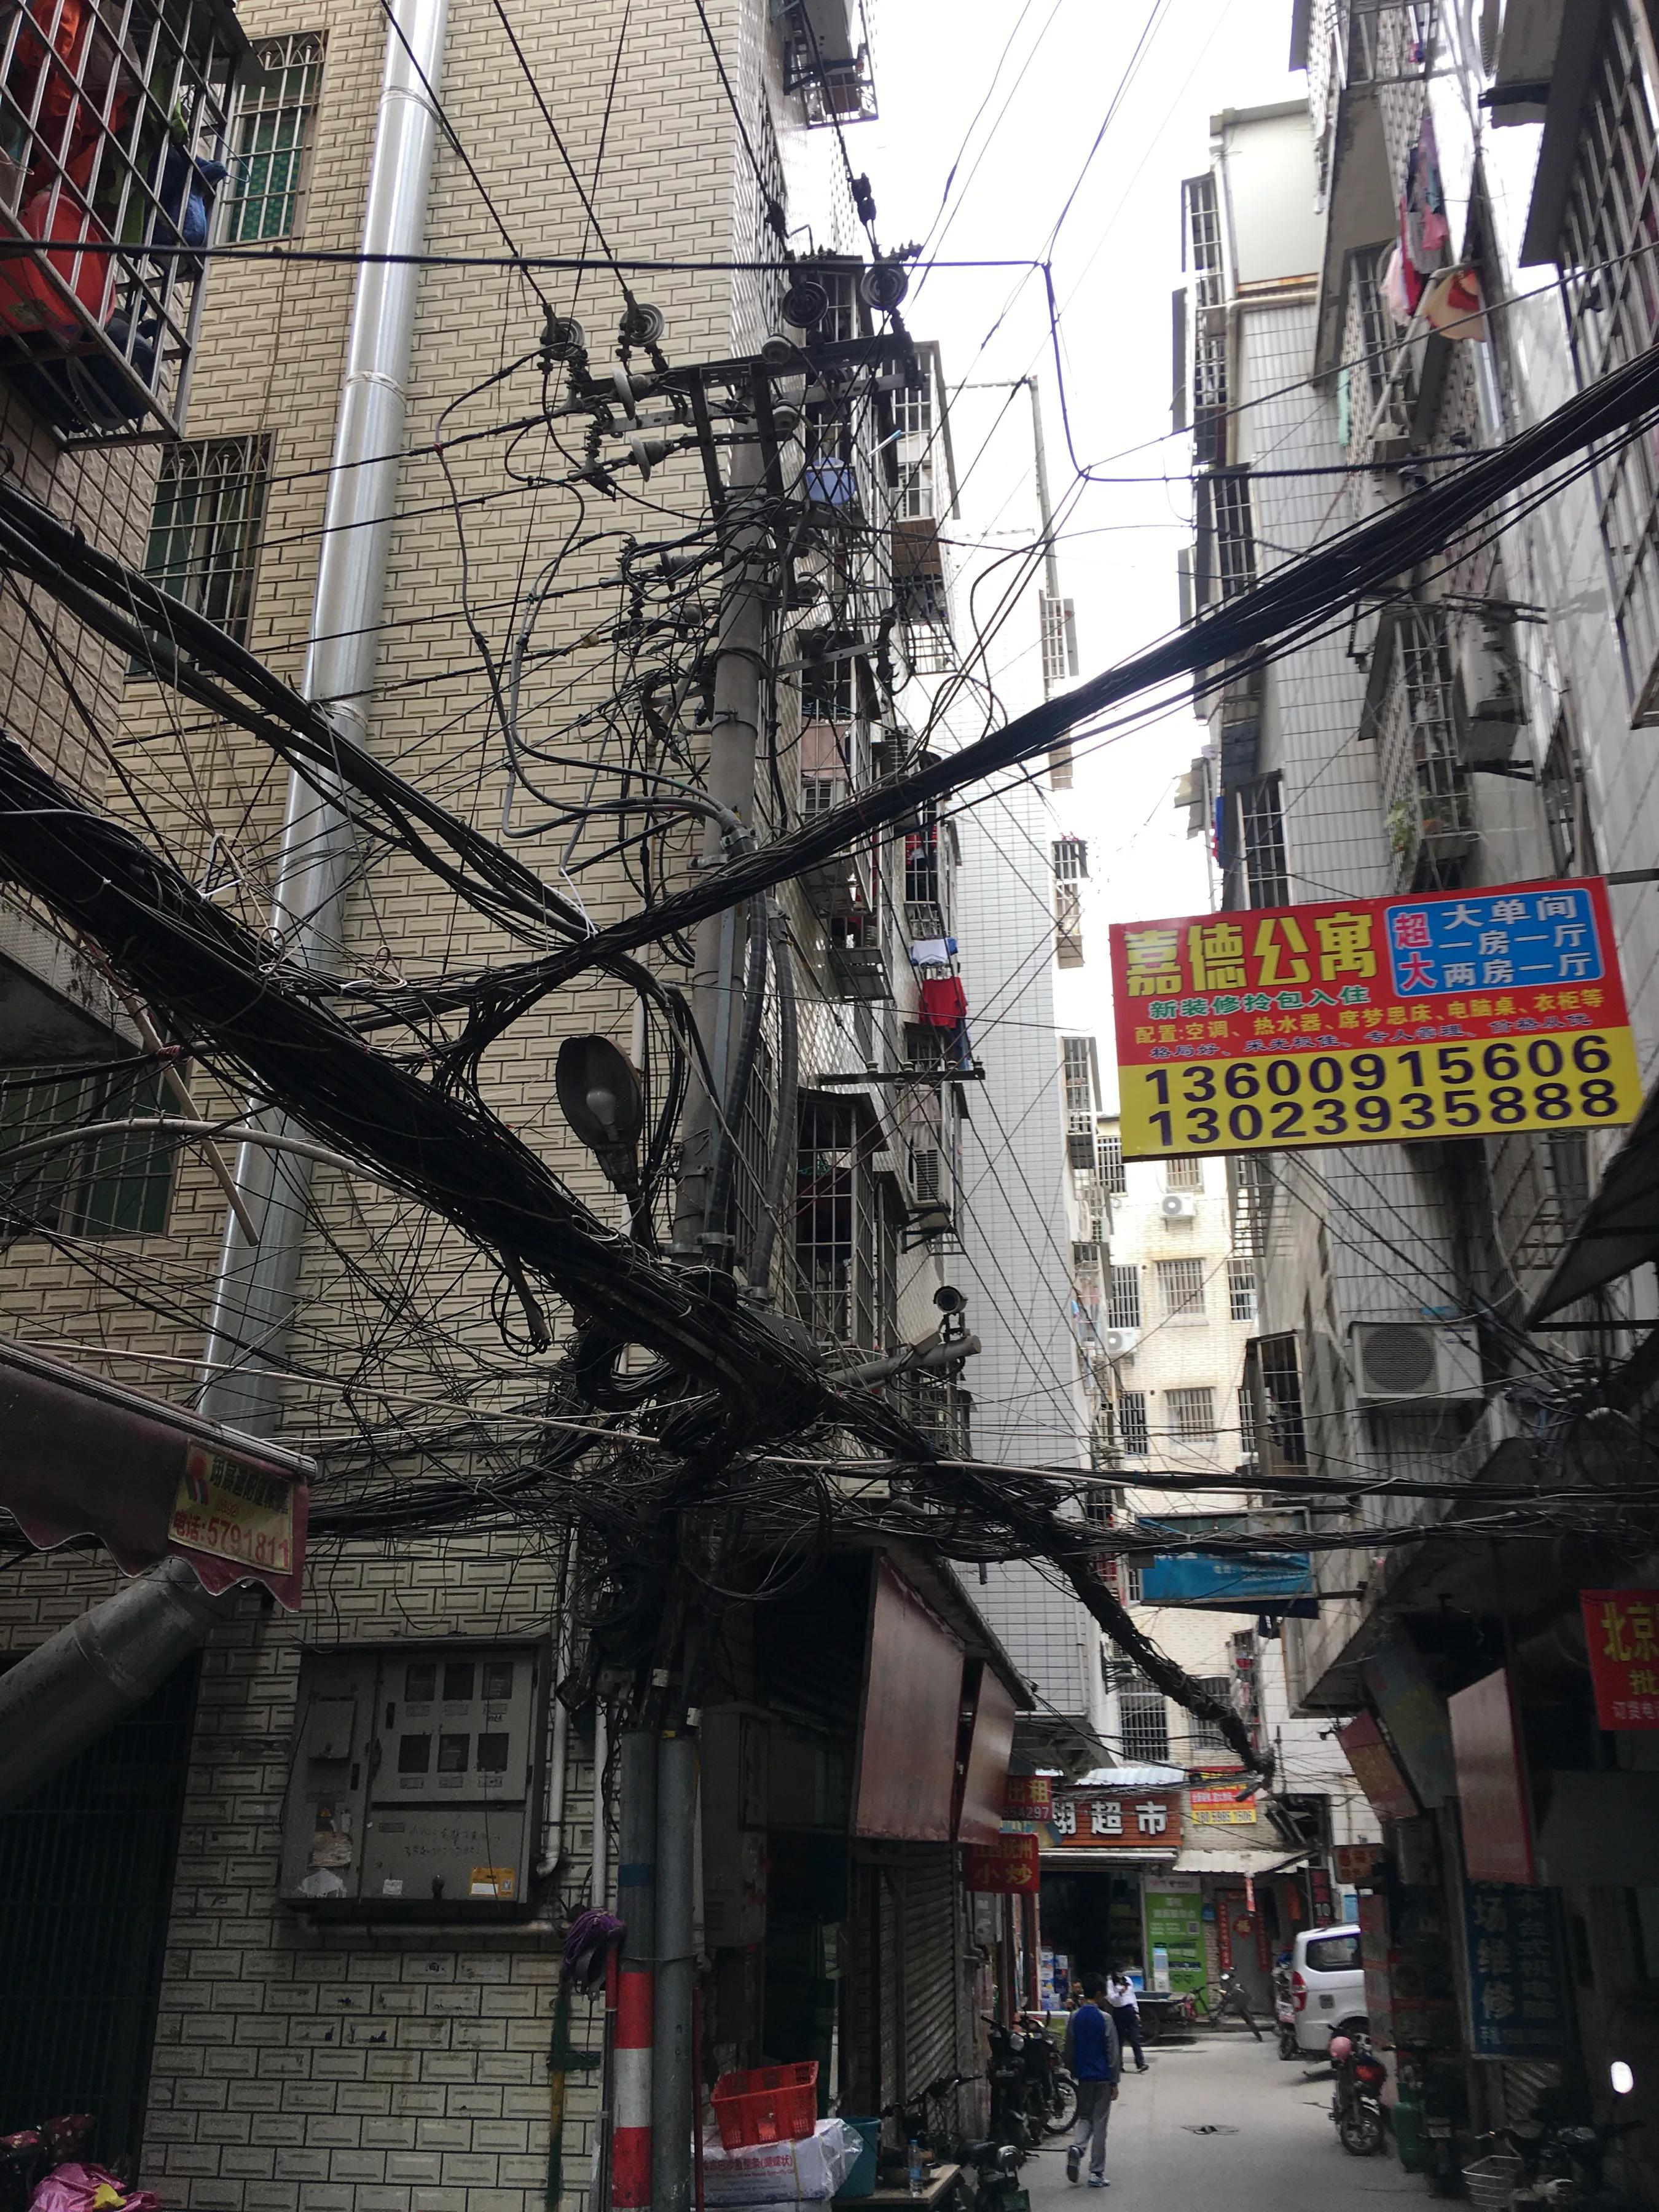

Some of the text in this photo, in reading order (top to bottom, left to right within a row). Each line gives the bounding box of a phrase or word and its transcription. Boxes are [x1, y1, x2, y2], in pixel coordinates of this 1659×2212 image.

[1441, 895, 1577, 930] 大单间
[1125, 911, 1378, 997] 嘉德公寓
[1393, 912, 1438, 991] 超大
[1439, 923, 1587, 955] 一房一厅
[1441, 952, 1592, 988] 两房一厅
[1149, 985, 1371, 1019] 新装修拎包入住
[1145, 1035, 1611, 1105] 13600915606
[1148, 1080, 1619, 1147] 13023935888
[1601, 1601, 1659, 1661] 北京
[1008, 1779, 1049, 1803] 出租
[974, 1863, 1033, 1885] 小炒
